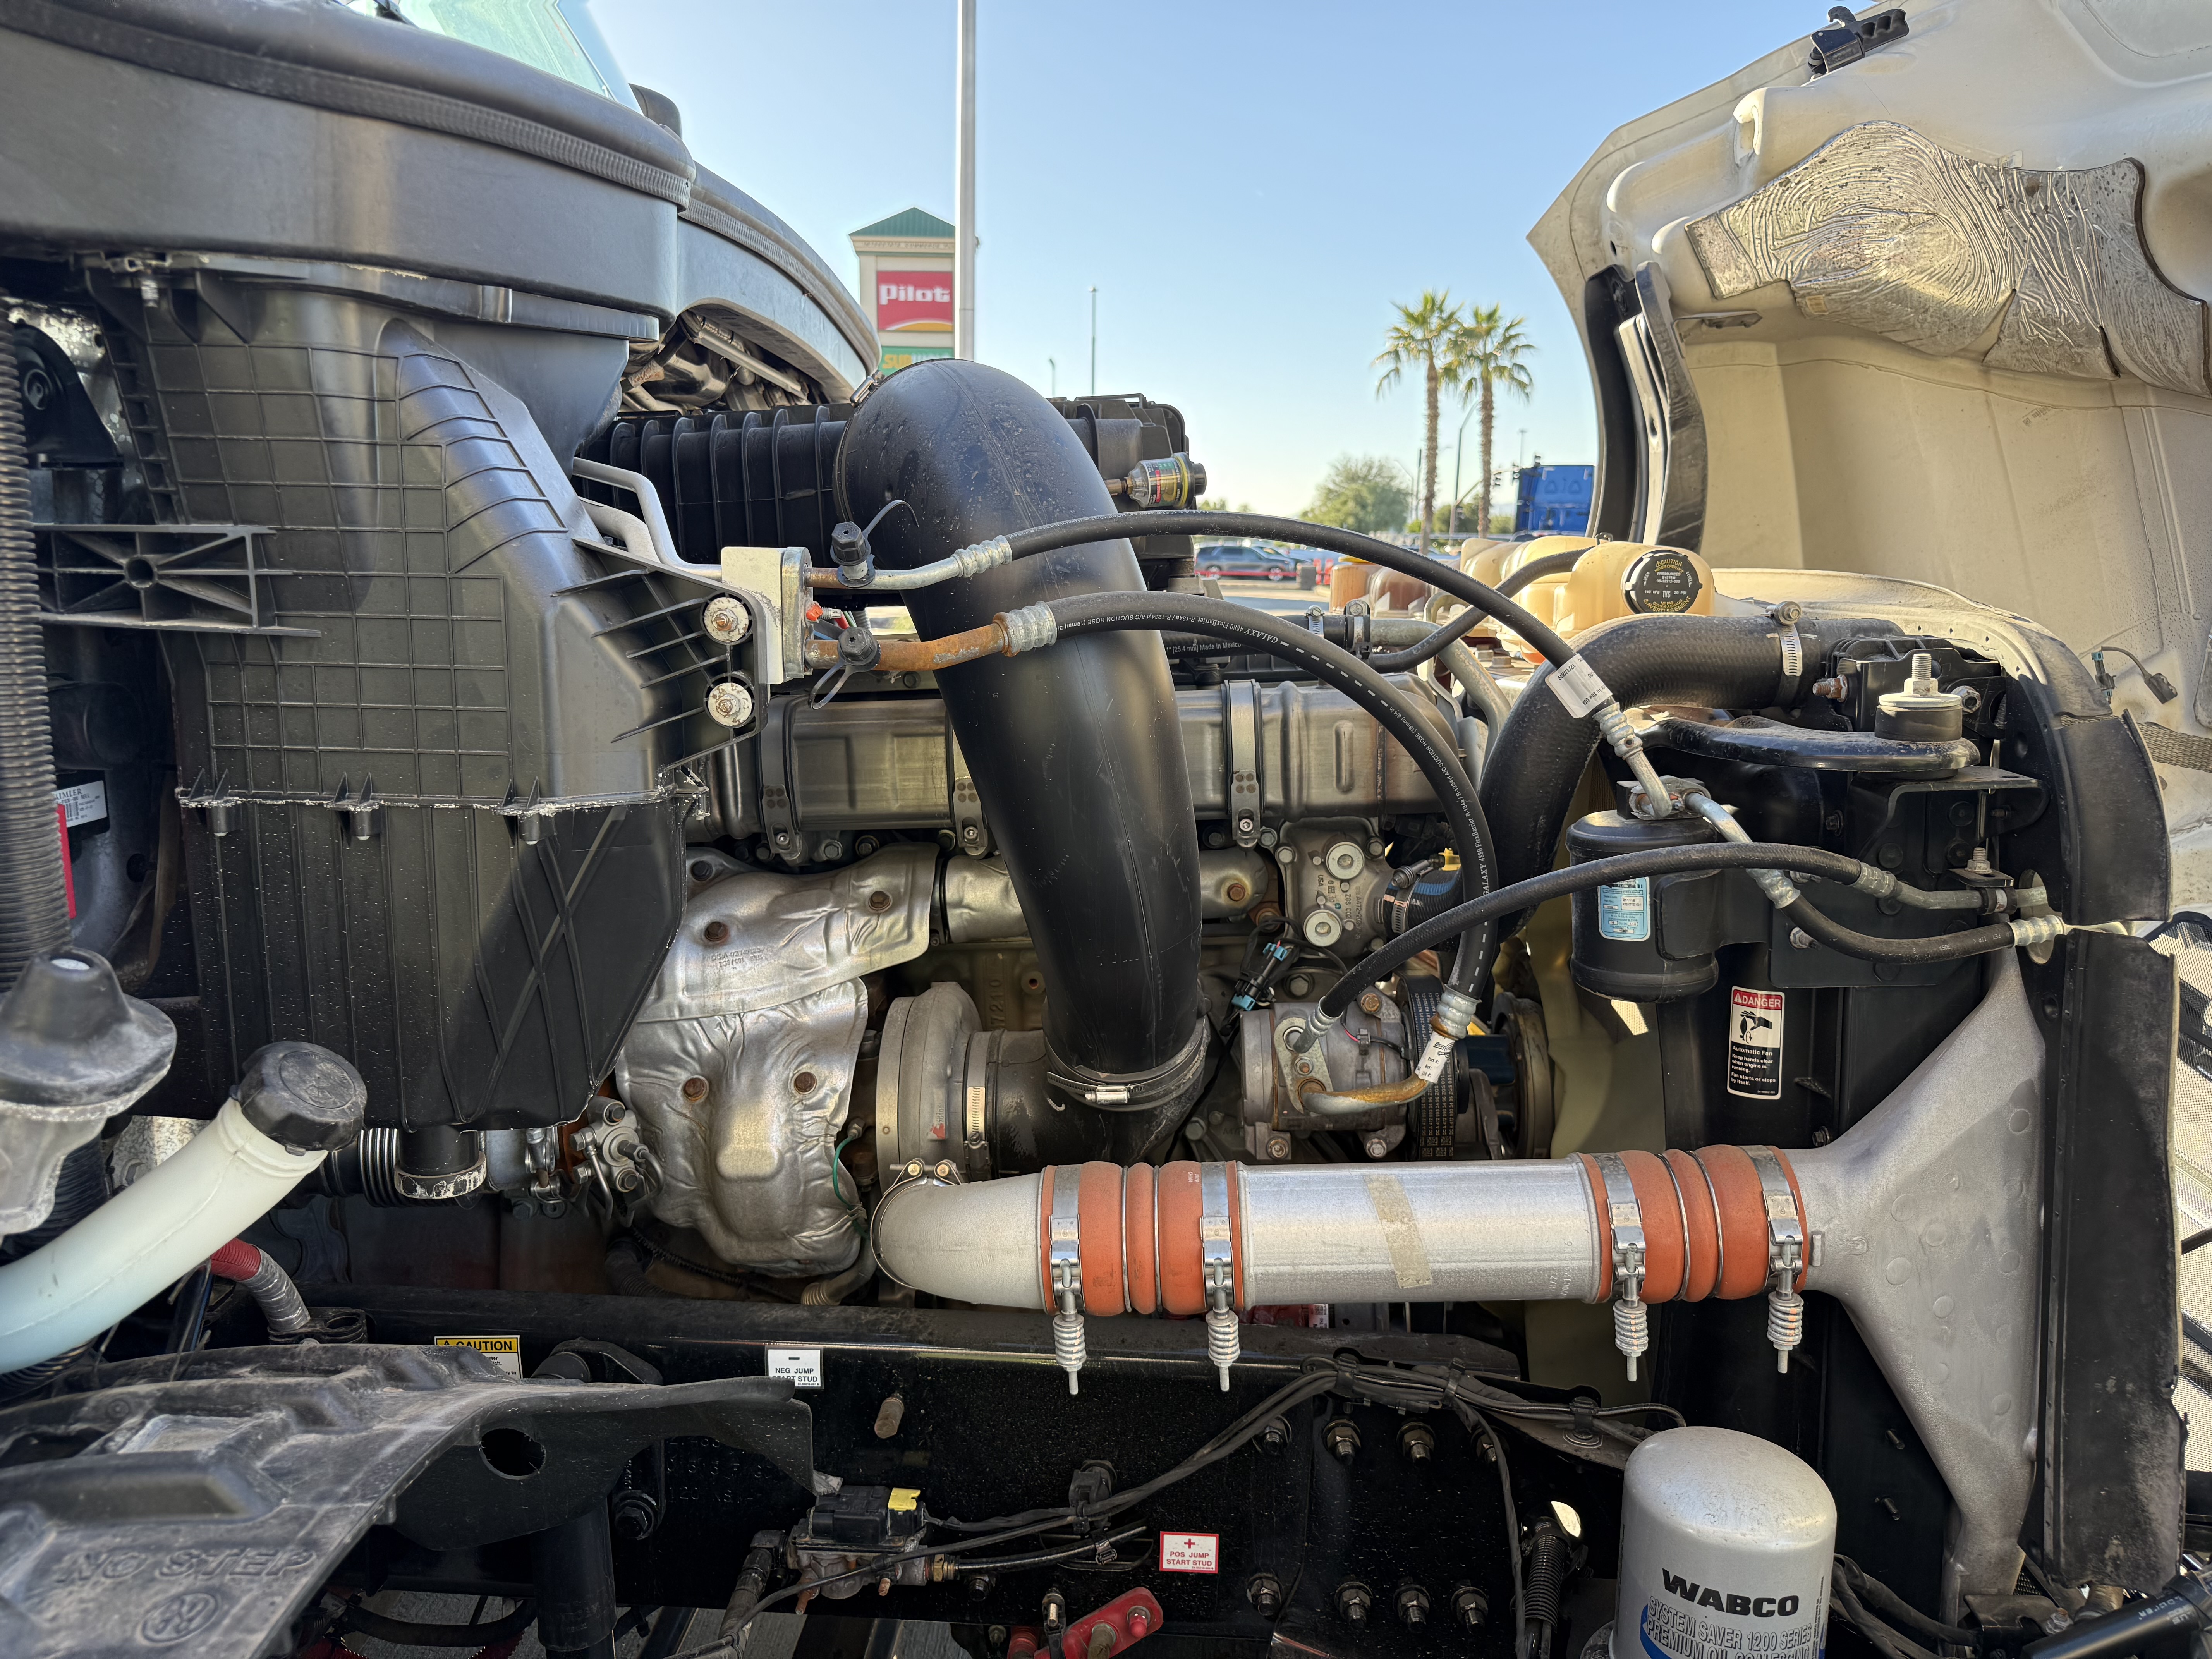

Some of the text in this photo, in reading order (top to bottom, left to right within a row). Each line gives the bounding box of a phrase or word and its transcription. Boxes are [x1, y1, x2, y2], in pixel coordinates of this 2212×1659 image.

[879, 284, 950, 305] Pilot
[883, 353, 950, 369] SUB
[1065, 620, 1086, 629] (19mm)
[1197, 617, 1229, 629] FlexBarrier
[1230, 624, 1244, 632] 4880
[1244, 628, 1279, 643] GALAXY
[1401, 717, 1417, 733] (19mm)
[1415, 732, 1427, 747] HOSE
[1426, 745, 1444, 768] SUCTION
[1441, 766, 1449, 776] A/C
[1468, 818, 1482, 847] FlexBarrier
[1742, 996, 1781, 1008] DANGER
[1732, 1046, 1760, 1055] Automatic
[56, 1548, 317, 1583] NO STEP
[1662, 1568, 1799, 1618] WABCO
[1649, 1596, 1812, 1651] SYSTEM SAVER 1200 SERIES
[1647, 1615, 1704, 1659] PREMIUM
[1707, 1646, 1728, 1659] OIL
